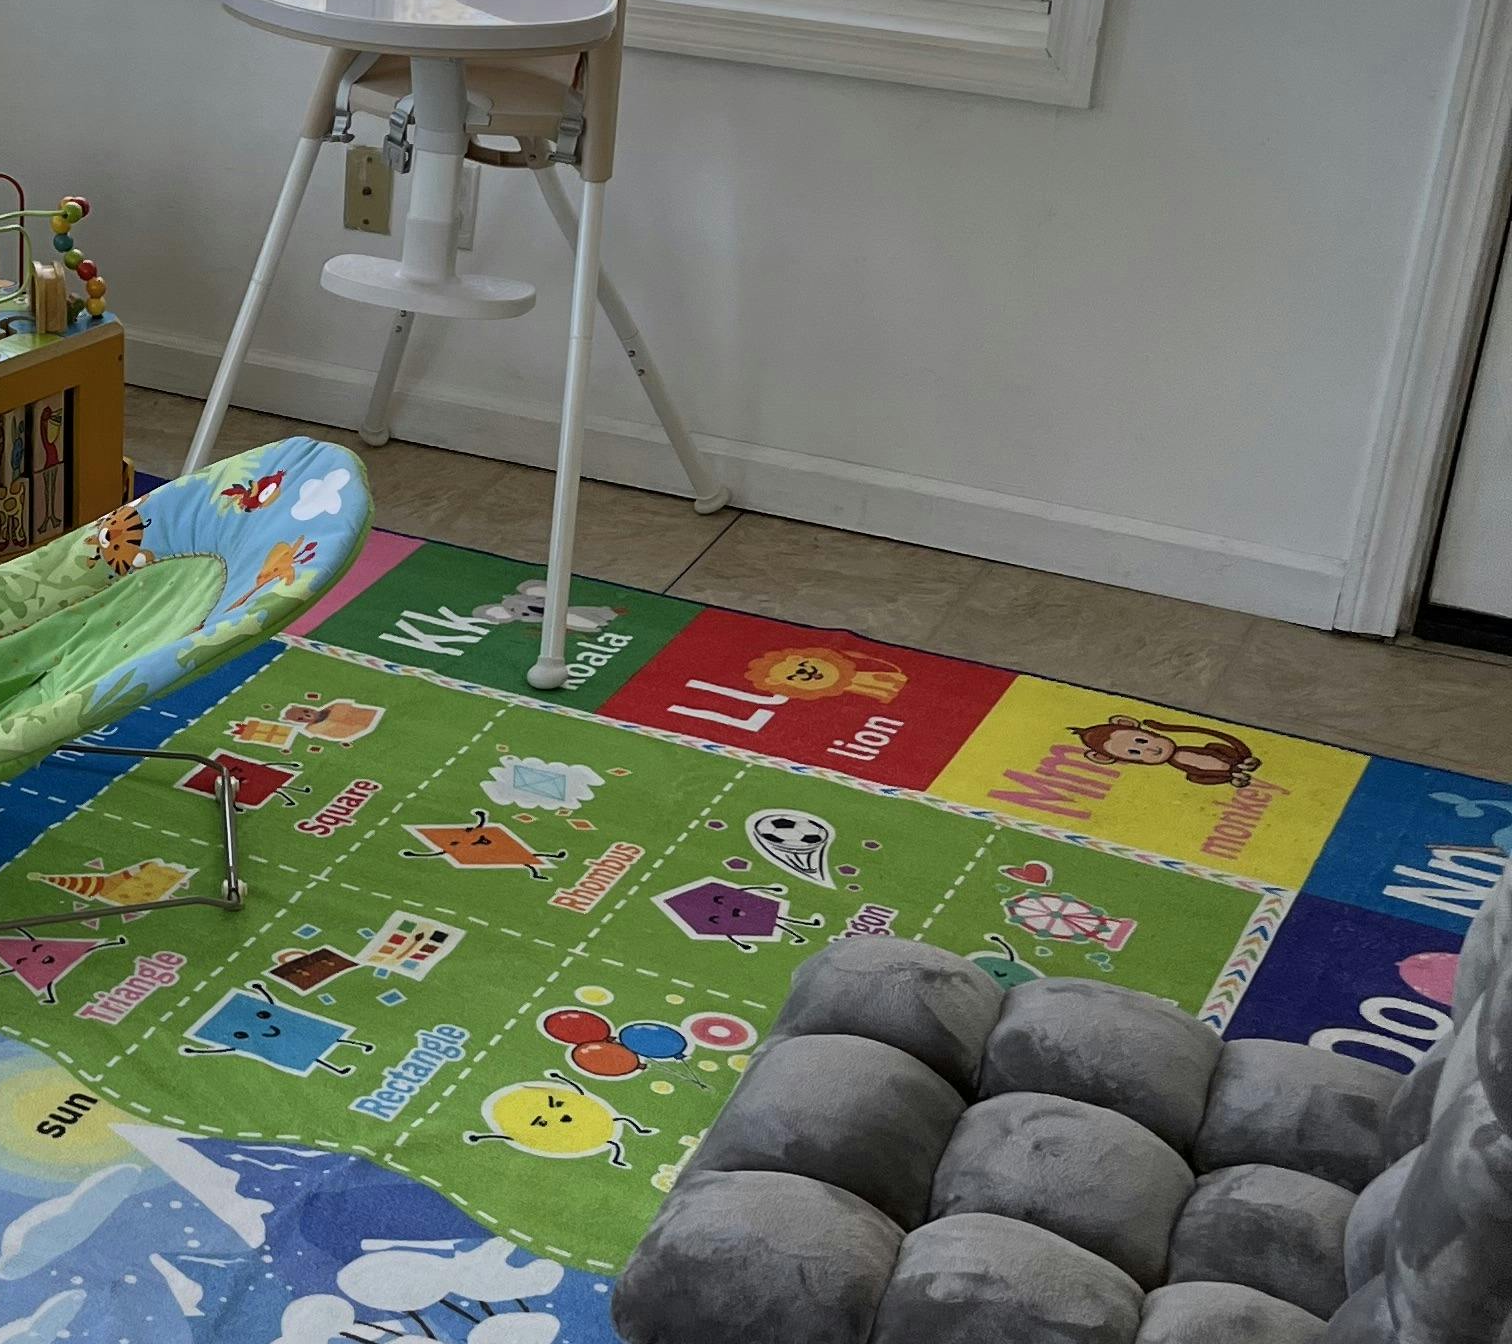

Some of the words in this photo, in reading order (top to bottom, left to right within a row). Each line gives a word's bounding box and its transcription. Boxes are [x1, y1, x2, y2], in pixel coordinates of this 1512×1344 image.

[379, 606, 493, 656] Kk
[667, 679, 789, 732] Ll
[51, 724, 119, 762] nne
[826, 714, 905, 761] lion
[298, 779, 380, 837] Square
[988, 744, 1121, 820] Mm
[1200, 779, 1291, 859] monkey
[554, 843, 642, 911] Rhombus
[1383, 848, 1508, 918] Nn
[80, 953, 185, 1022] Triangle
[356, 1026, 465, 1119] Rectangle
[36, 1091, 99, 1140] sun
